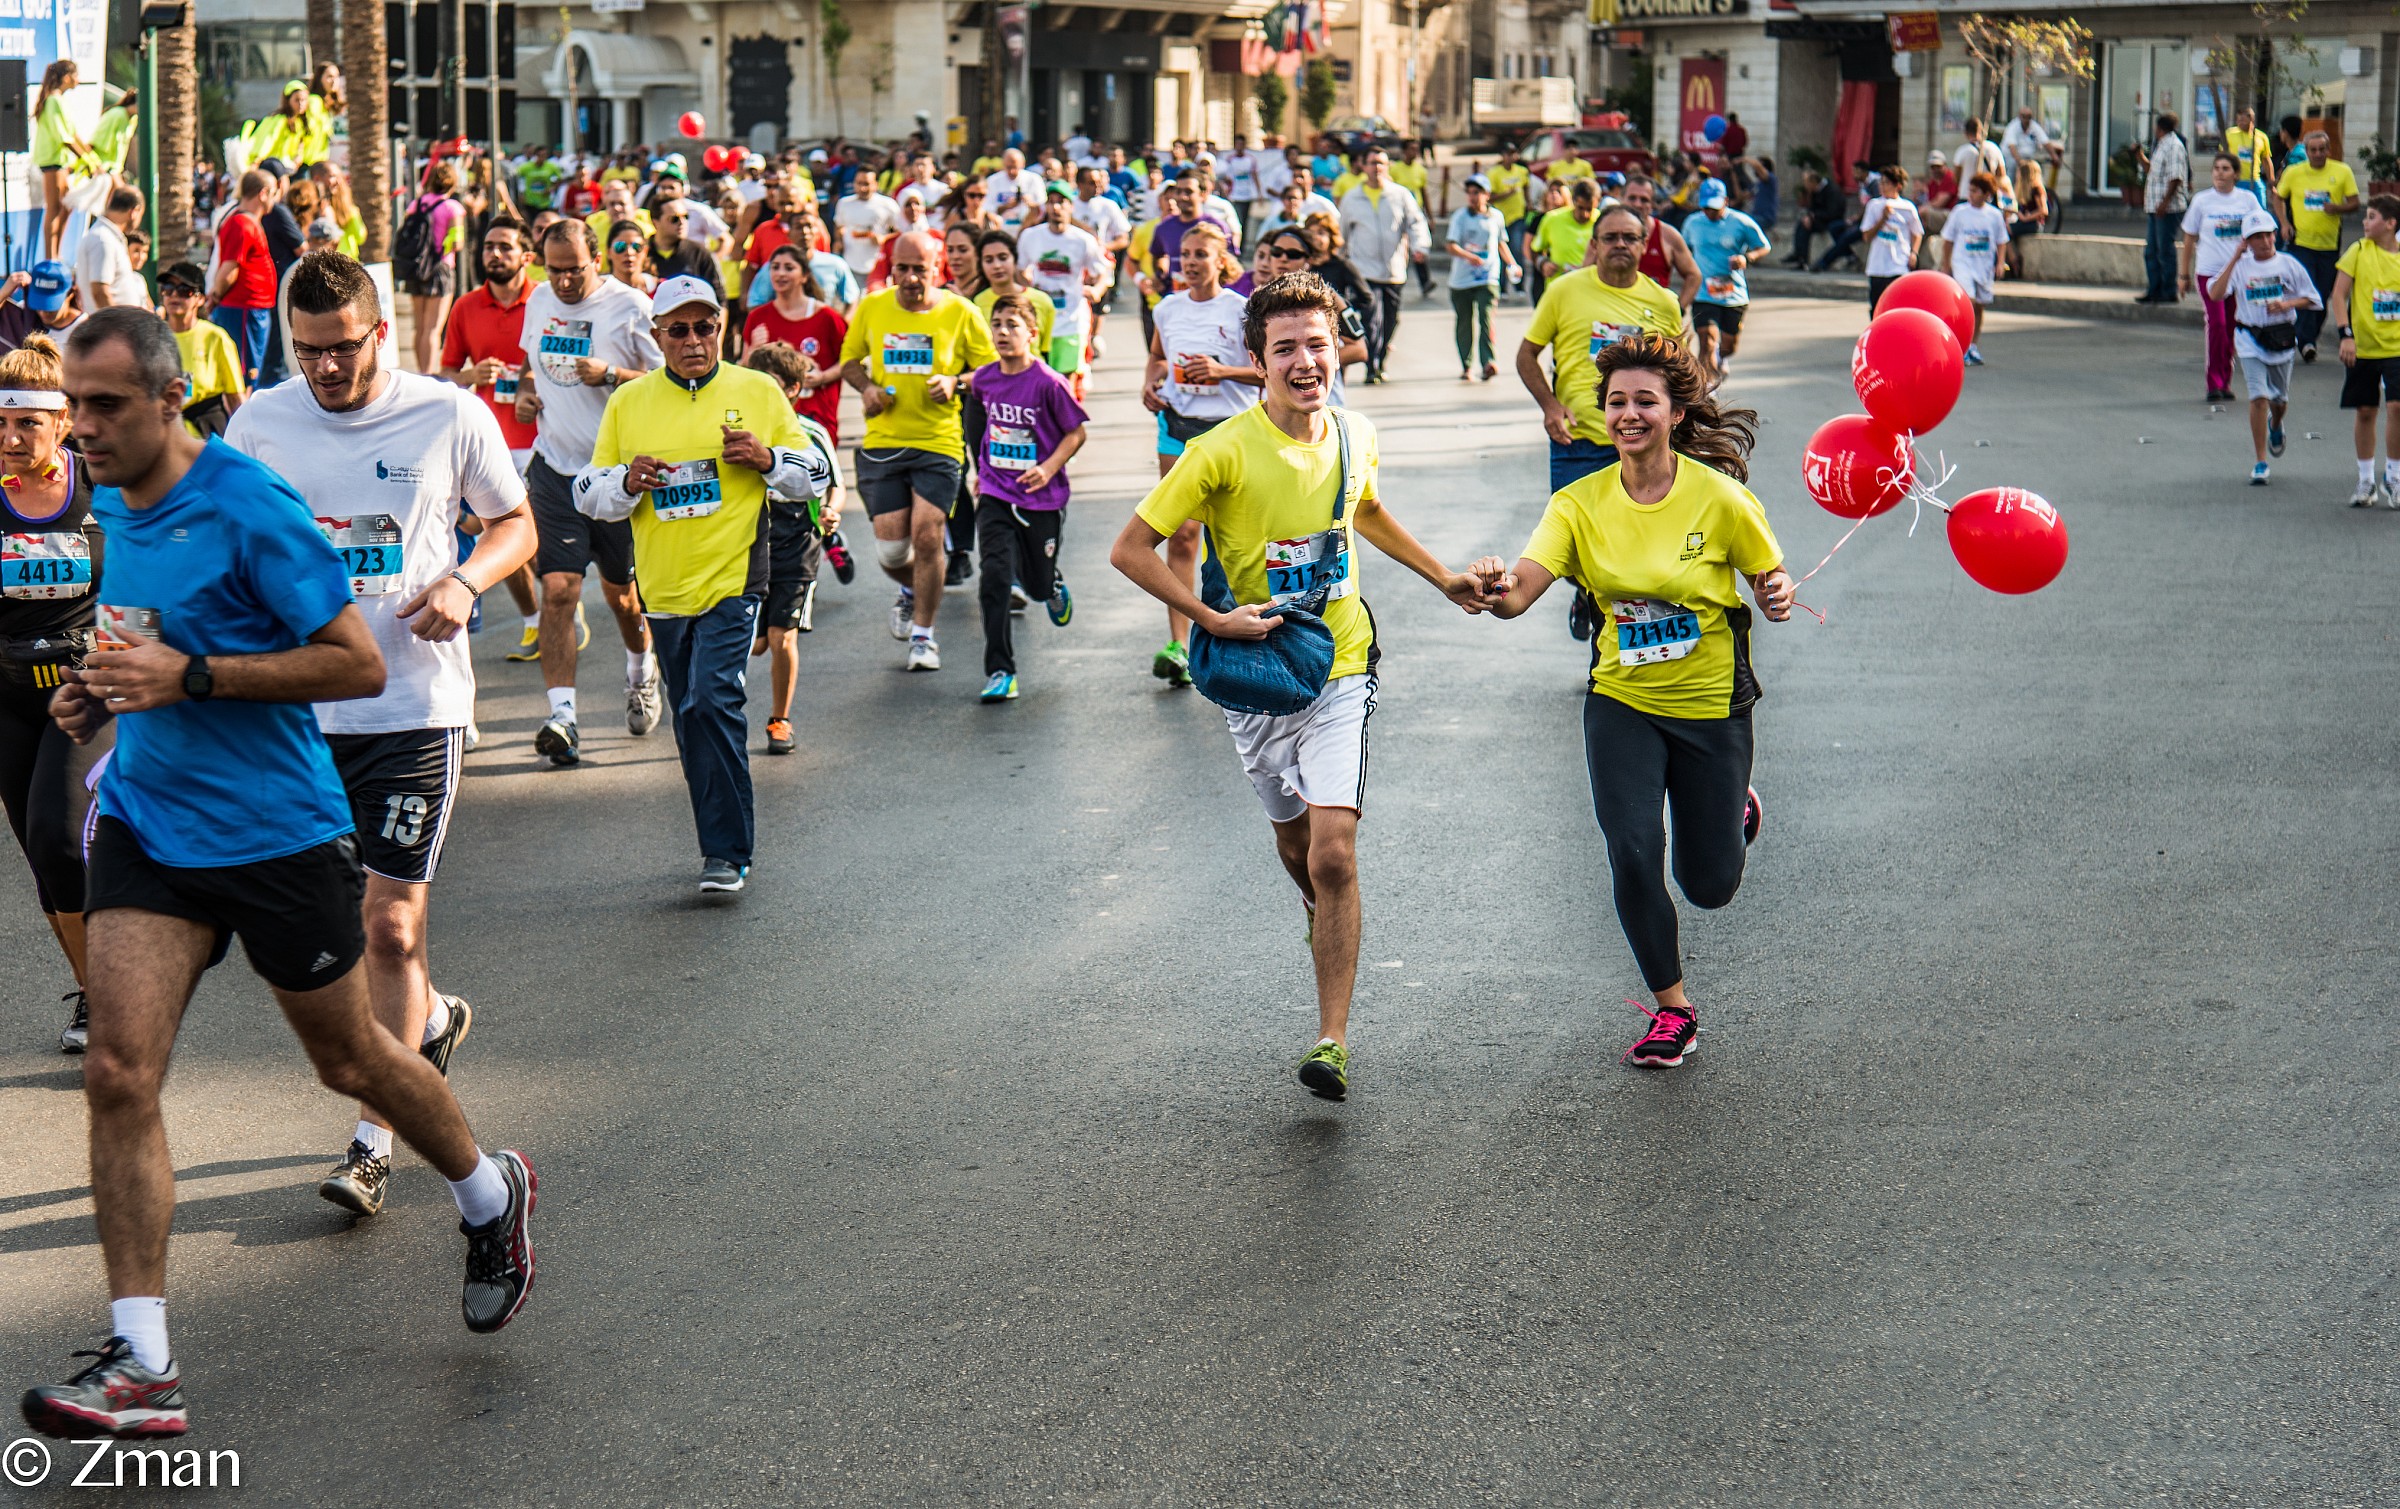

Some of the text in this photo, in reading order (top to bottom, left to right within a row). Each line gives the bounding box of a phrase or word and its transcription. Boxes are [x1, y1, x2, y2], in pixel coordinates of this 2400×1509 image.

[545, 337, 583, 354] 22681
[982, 401, 1037, 425] ABIS
[993, 442, 1031, 459] 23212
[658, 483, 714, 508] 20995
[18, 560, 75, 584] 4413
[1626, 617, 1692, 647] 21145
[381, 795, 427, 845] 13
